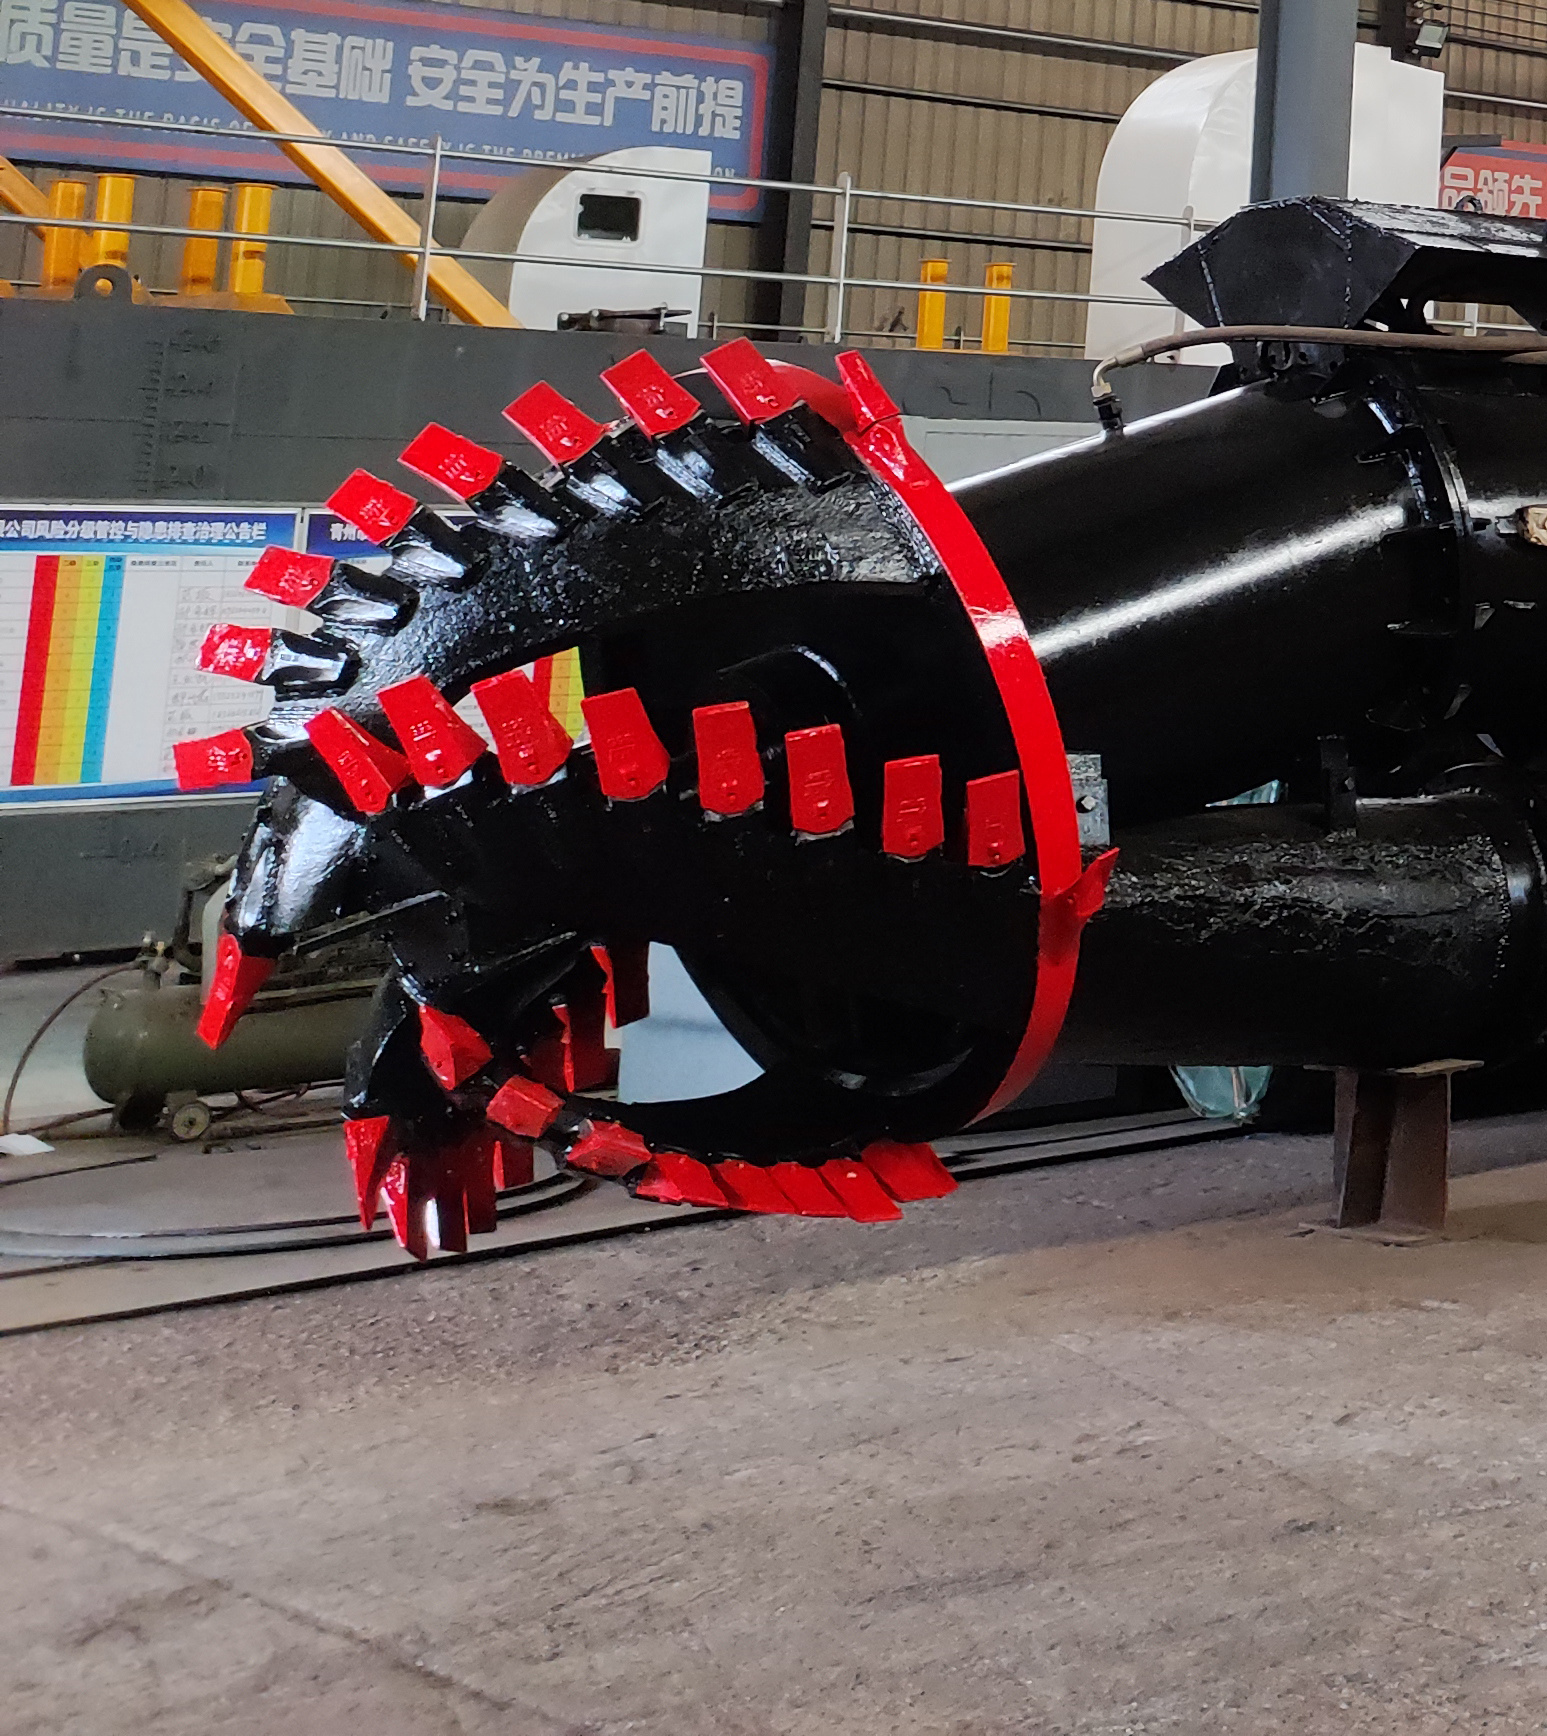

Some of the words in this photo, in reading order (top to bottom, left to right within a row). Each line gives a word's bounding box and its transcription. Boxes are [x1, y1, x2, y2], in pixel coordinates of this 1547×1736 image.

[405, 44, 744, 140] 安全为生产前提
